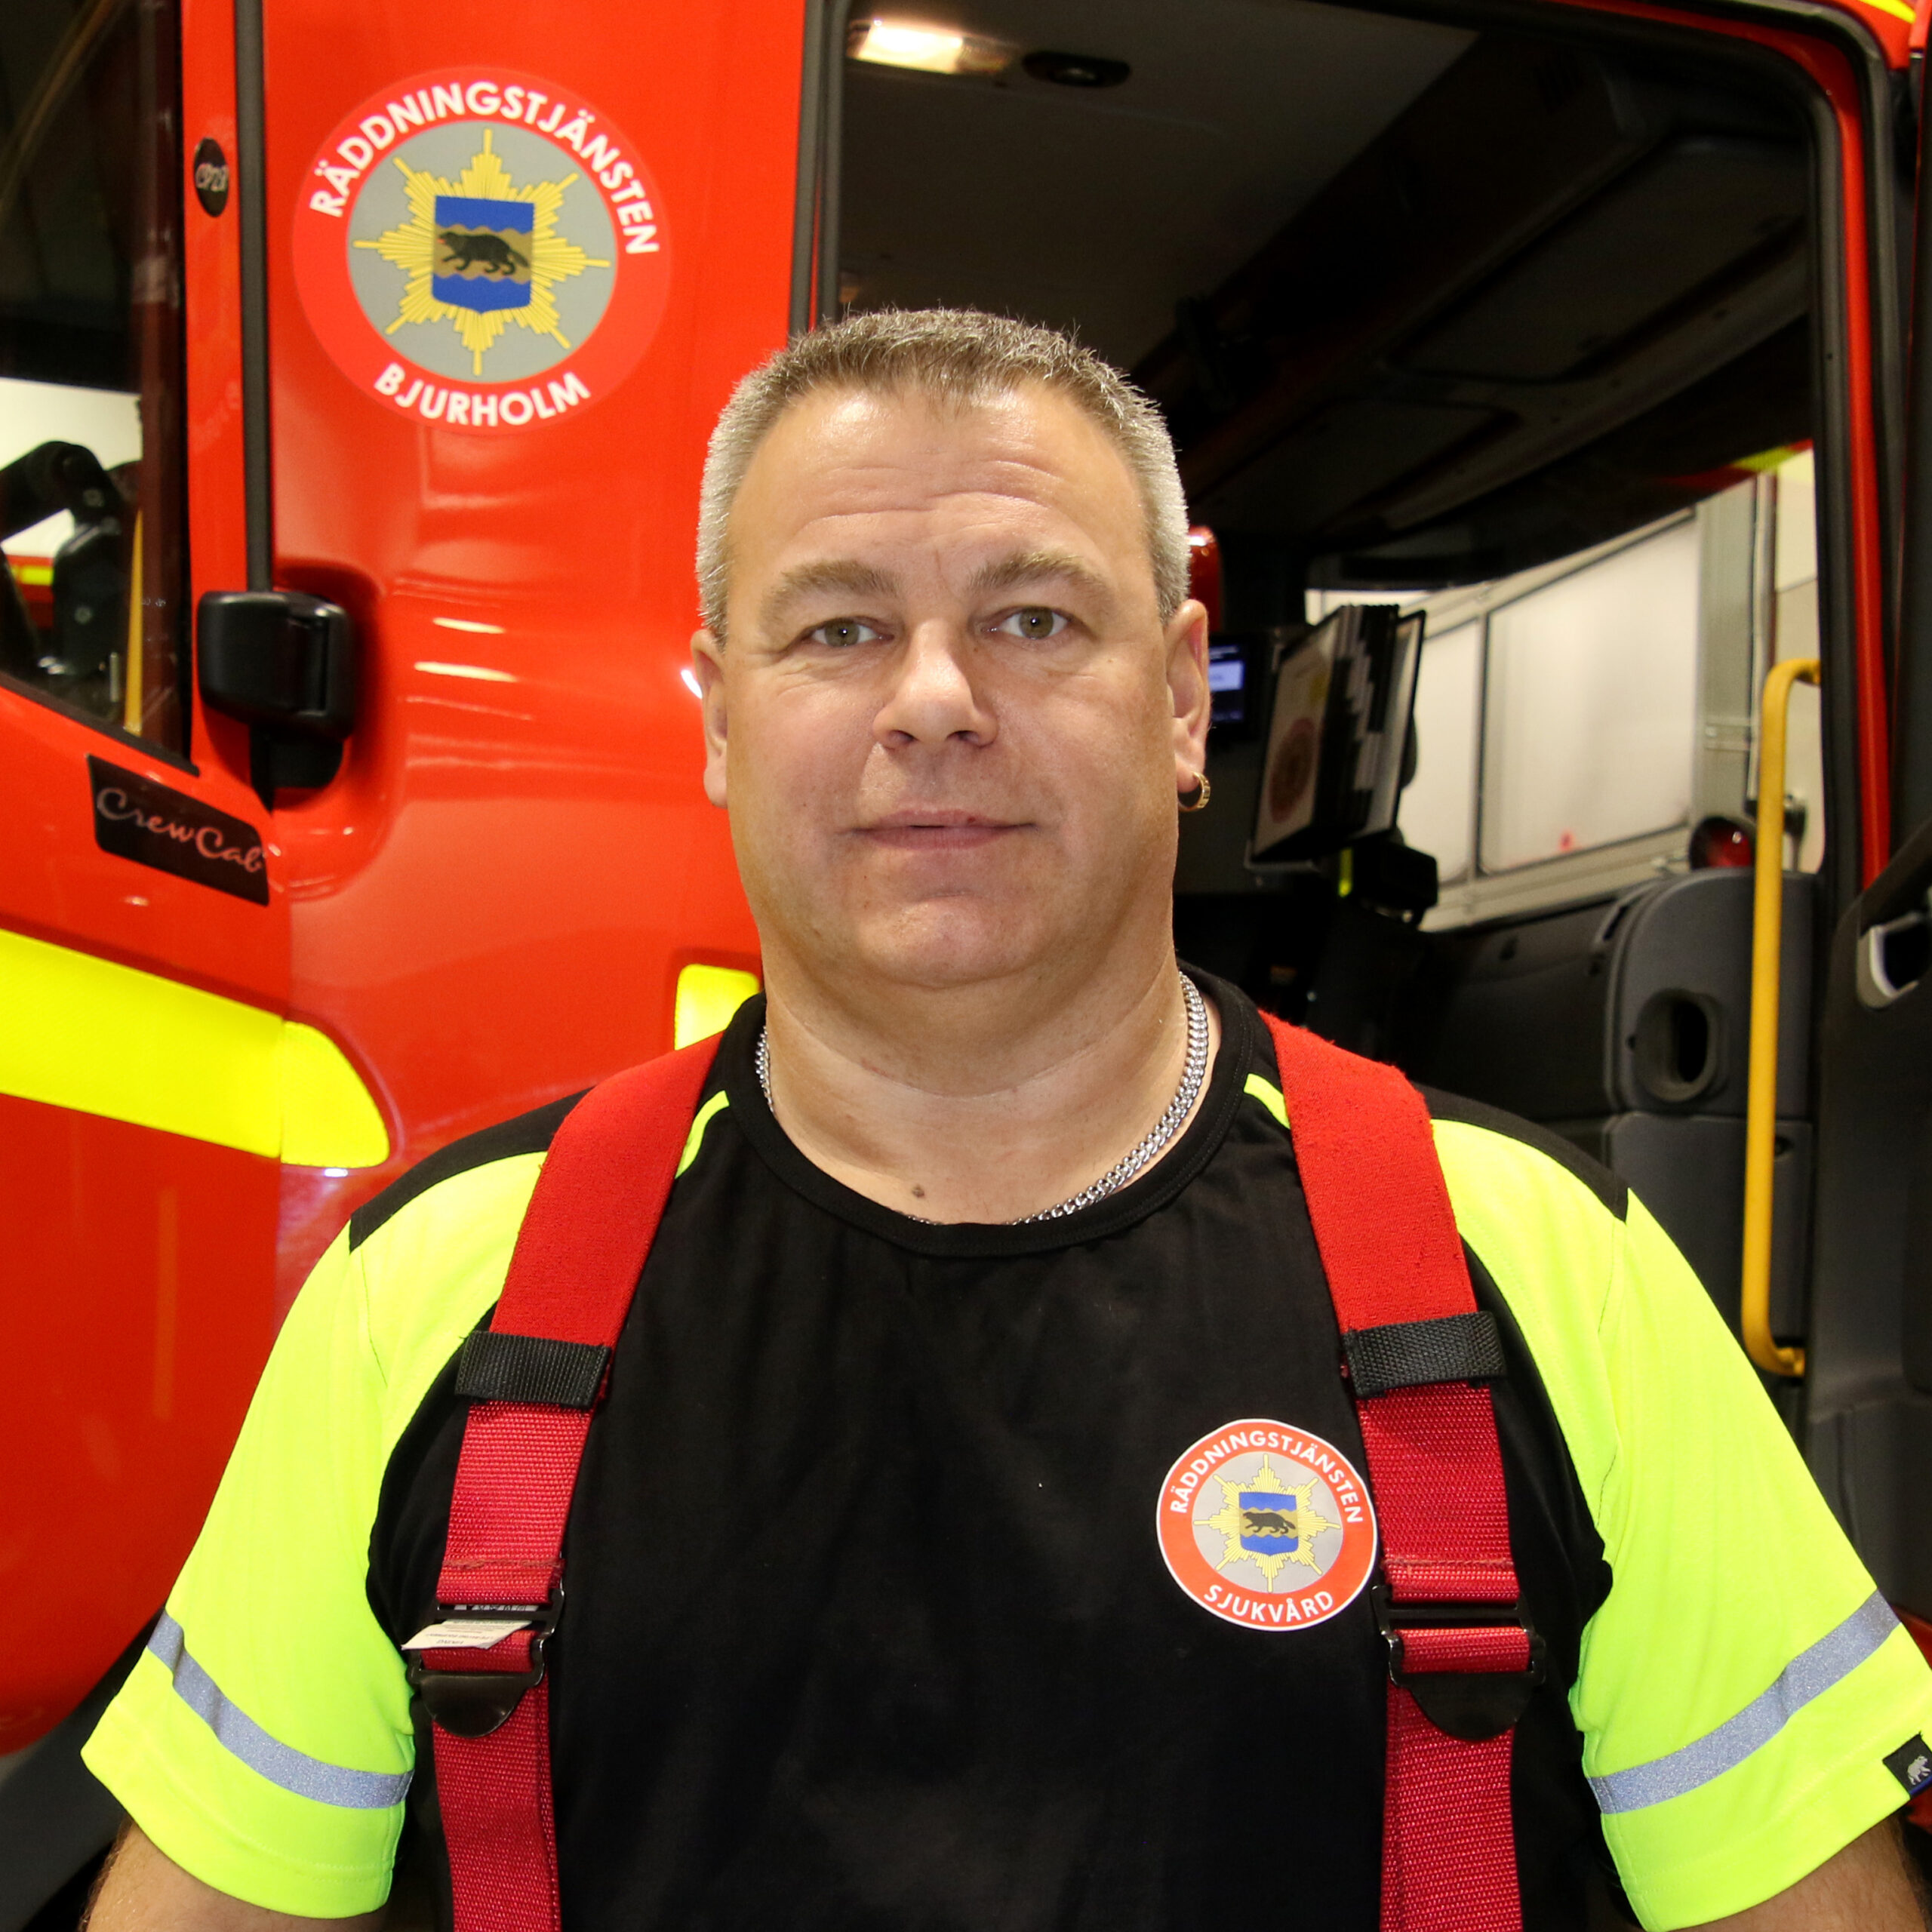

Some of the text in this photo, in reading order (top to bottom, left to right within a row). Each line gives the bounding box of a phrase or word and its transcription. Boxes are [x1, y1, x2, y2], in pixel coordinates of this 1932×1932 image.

[310, 82, 660, 255] RÄDDNINGSTJÄNSTEN
[374, 363, 591, 427] BJURHOLM
[1171, 1430, 1363, 1523] RÄDDNINGSTJÄNSTEN
[1204, 1585, 1334, 1623] SJUKVÅRD
